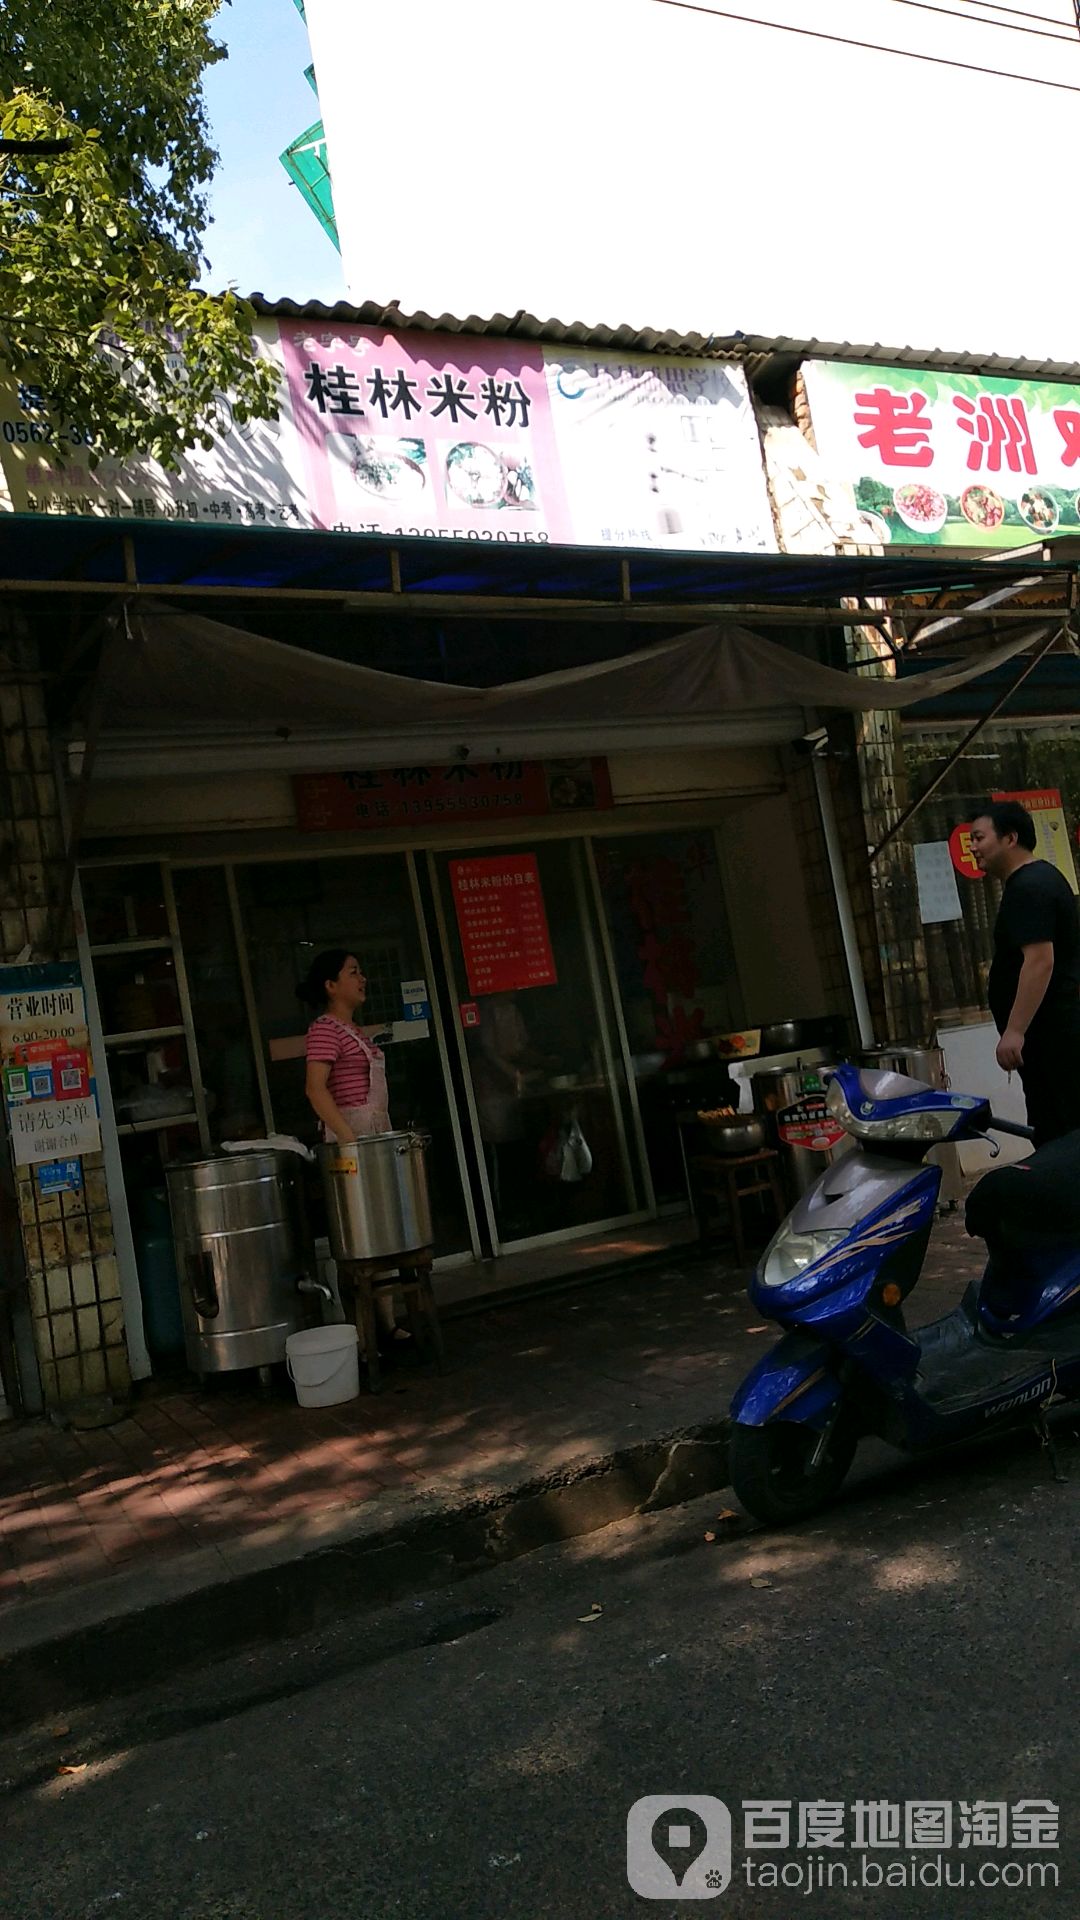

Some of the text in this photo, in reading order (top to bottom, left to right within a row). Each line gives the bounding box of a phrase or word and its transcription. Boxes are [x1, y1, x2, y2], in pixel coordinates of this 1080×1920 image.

[304, 362, 531, 428] 桂林米粉
[355, 800, 390, 817] 电话
[8, 993, 74, 1020] 营业时间
[19, 1103, 90, 1133] 请先买单
